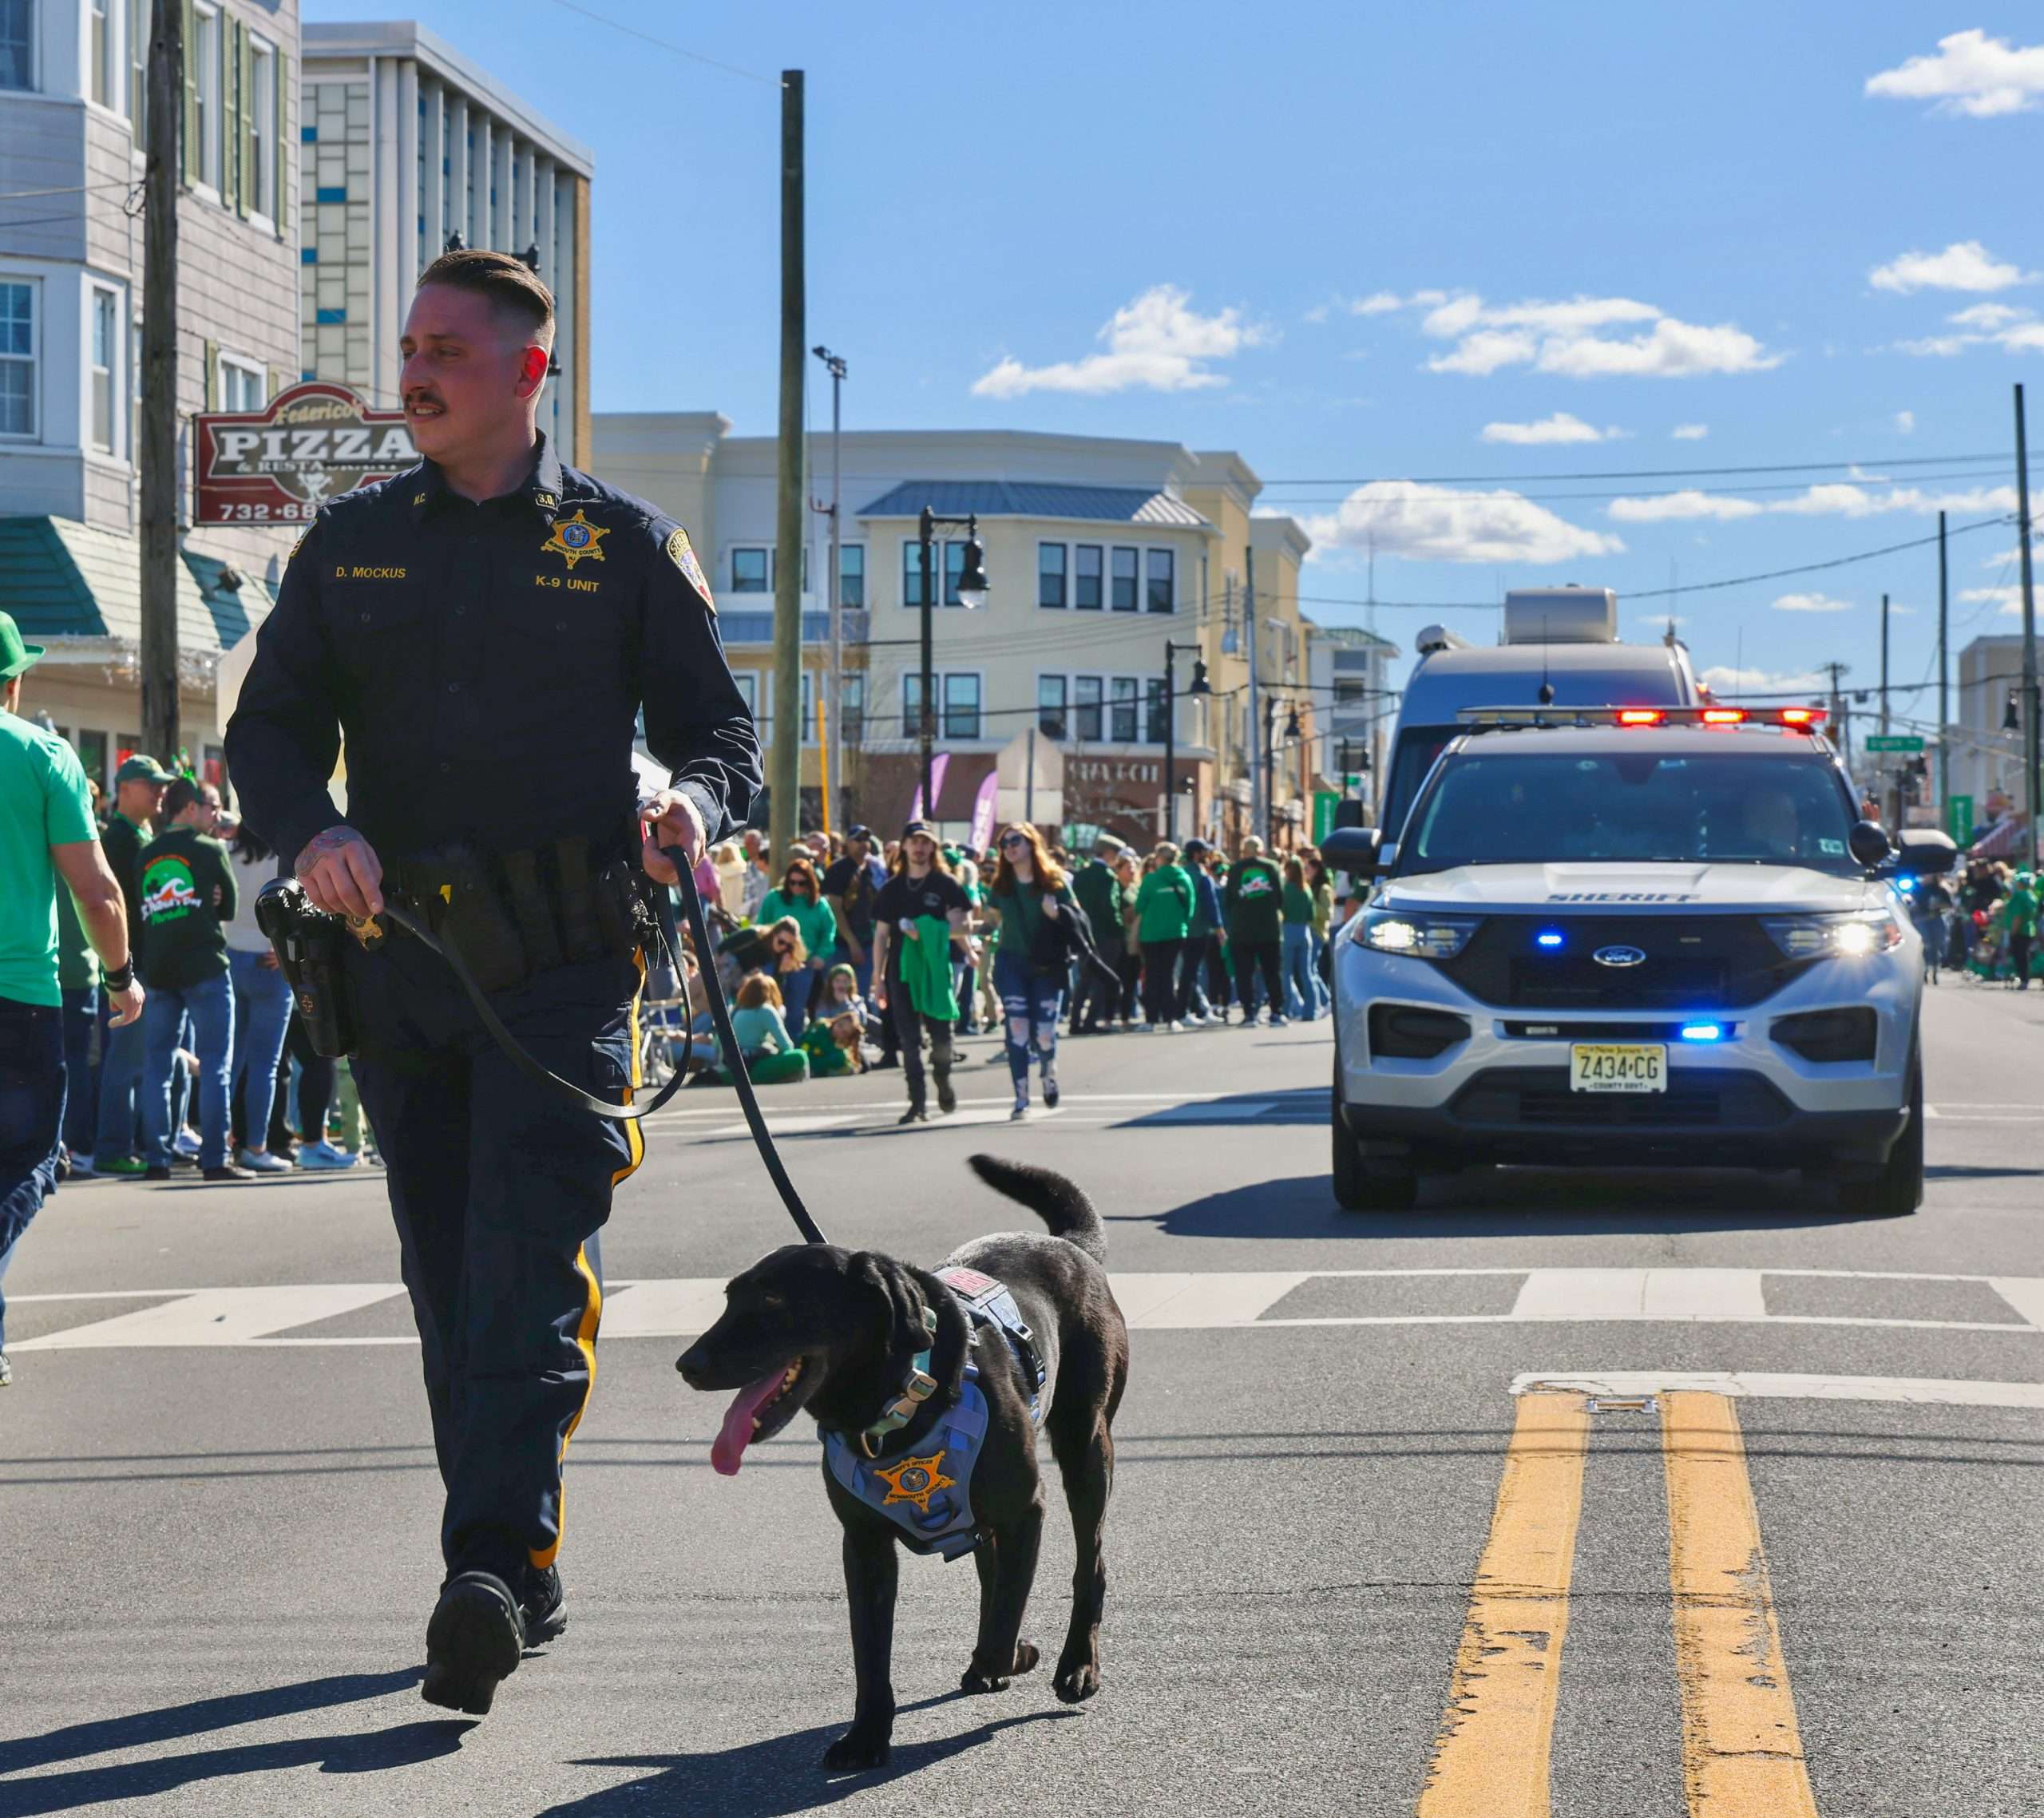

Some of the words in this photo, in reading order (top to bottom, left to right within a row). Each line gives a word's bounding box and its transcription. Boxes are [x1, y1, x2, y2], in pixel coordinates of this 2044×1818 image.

[274, 398, 364, 426] Federico's
[218, 428, 422, 461] PIZZA
[236, 461, 252, 473] &
[335, 566, 347, 578] D.
[352, 566, 406, 579] MOCKUS
[536, 575, 561, 588] K-9
[567, 578, 600, 592] UNIT
[1547, 893, 1702, 902] SHERIFF
